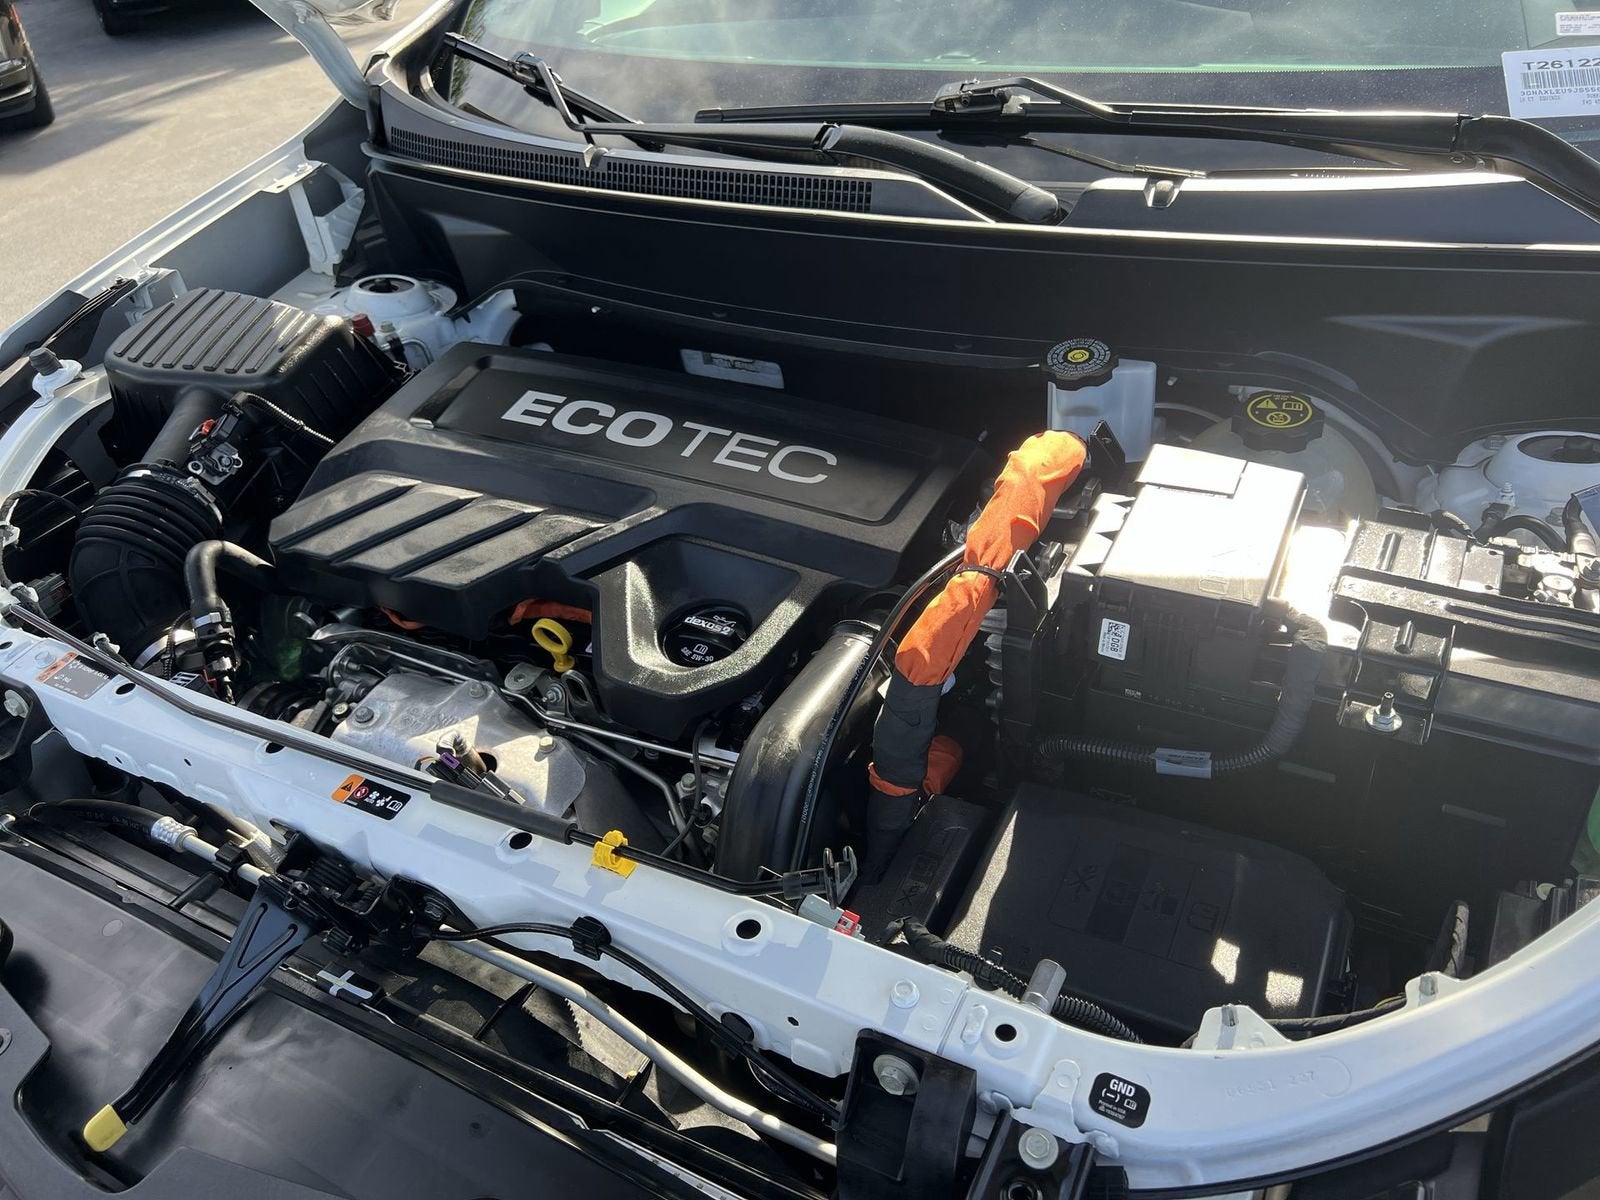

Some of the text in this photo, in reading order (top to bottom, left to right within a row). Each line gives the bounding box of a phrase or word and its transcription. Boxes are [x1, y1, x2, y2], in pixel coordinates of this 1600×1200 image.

[501, 389, 838, 485] ECOTEC
[684, 615, 732, 636] dexos2
[680, 646, 714, 663] SAE 5W-30
[1109, 1078, 1136, 1097] GND
